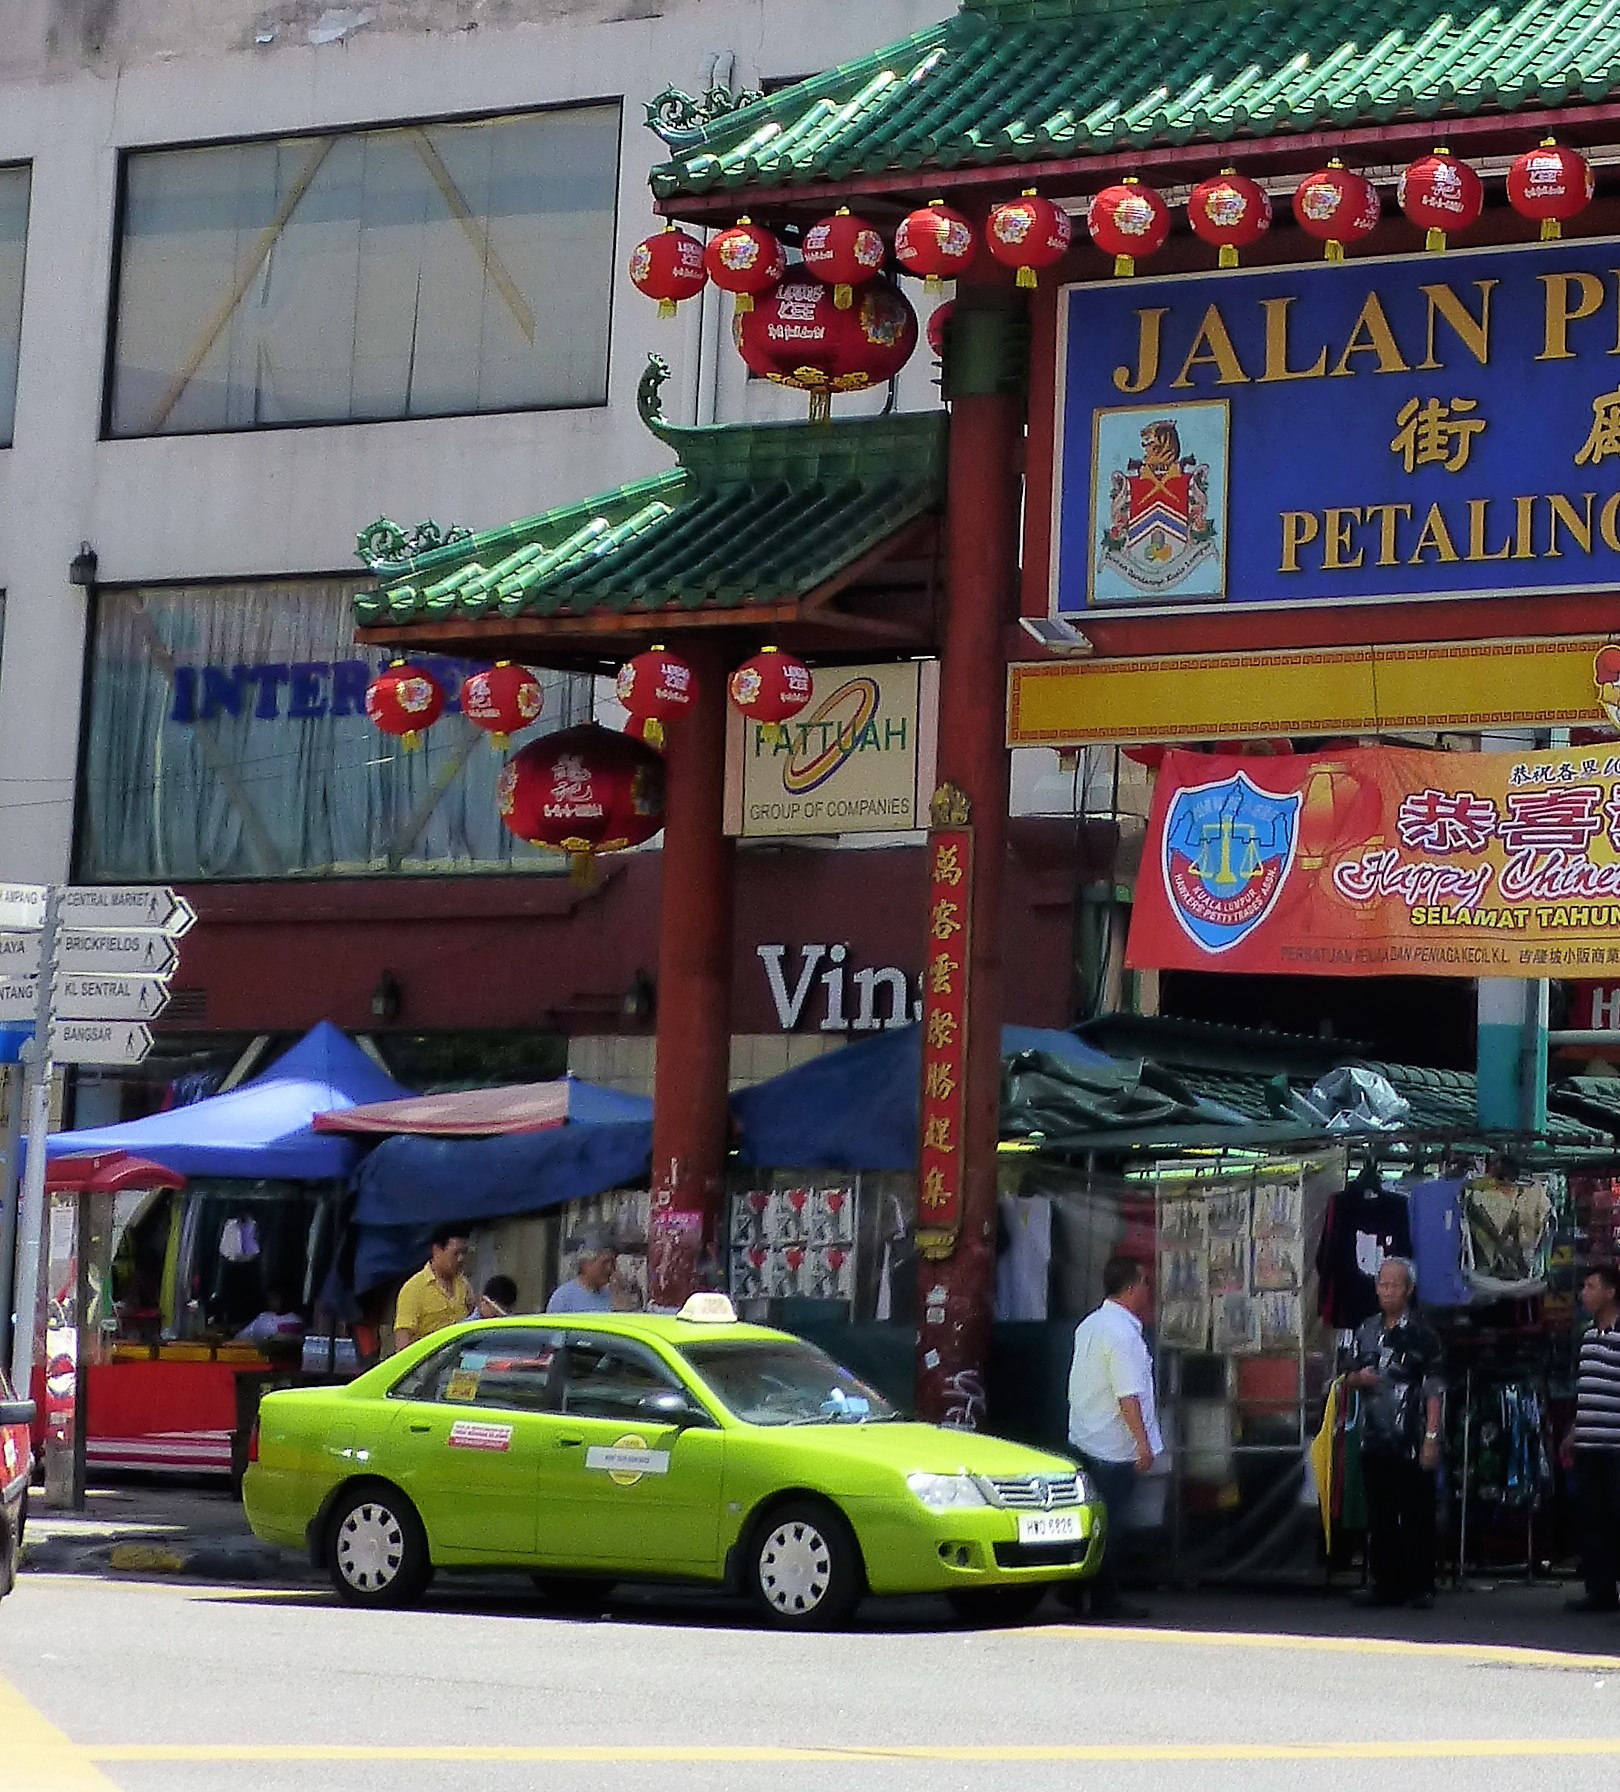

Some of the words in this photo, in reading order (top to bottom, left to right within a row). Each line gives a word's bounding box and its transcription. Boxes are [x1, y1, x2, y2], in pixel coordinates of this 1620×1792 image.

[1112, 279, 1499, 394] JALAN
[754, 717, 907, 757] FATTUAH
[750, 801, 800, 821] GROUP
[803, 800, 825, 820] OF
[827, 797, 910, 819] COMPANIES
[1333, 848, 1493, 911] Happy
[67, 892, 109, 906] CENTRAL
[112, 892, 149, 907] MARKET
[1192, 885, 1221, 911] KUALA
[1224, 888, 1258, 912] LUMPUR
[1411, 905, 1530, 929] SELAMAT
[65, 937, 140, 952] BRICKFIELDS
[1389, 946, 1412, 962] DAN
[64, 982, 78, 997] KL
[81, 982, 131, 997] SENTRAL
[757, 943, 922, 1031] Vin
[63, 1027, 112, 1042] BANGSAR
